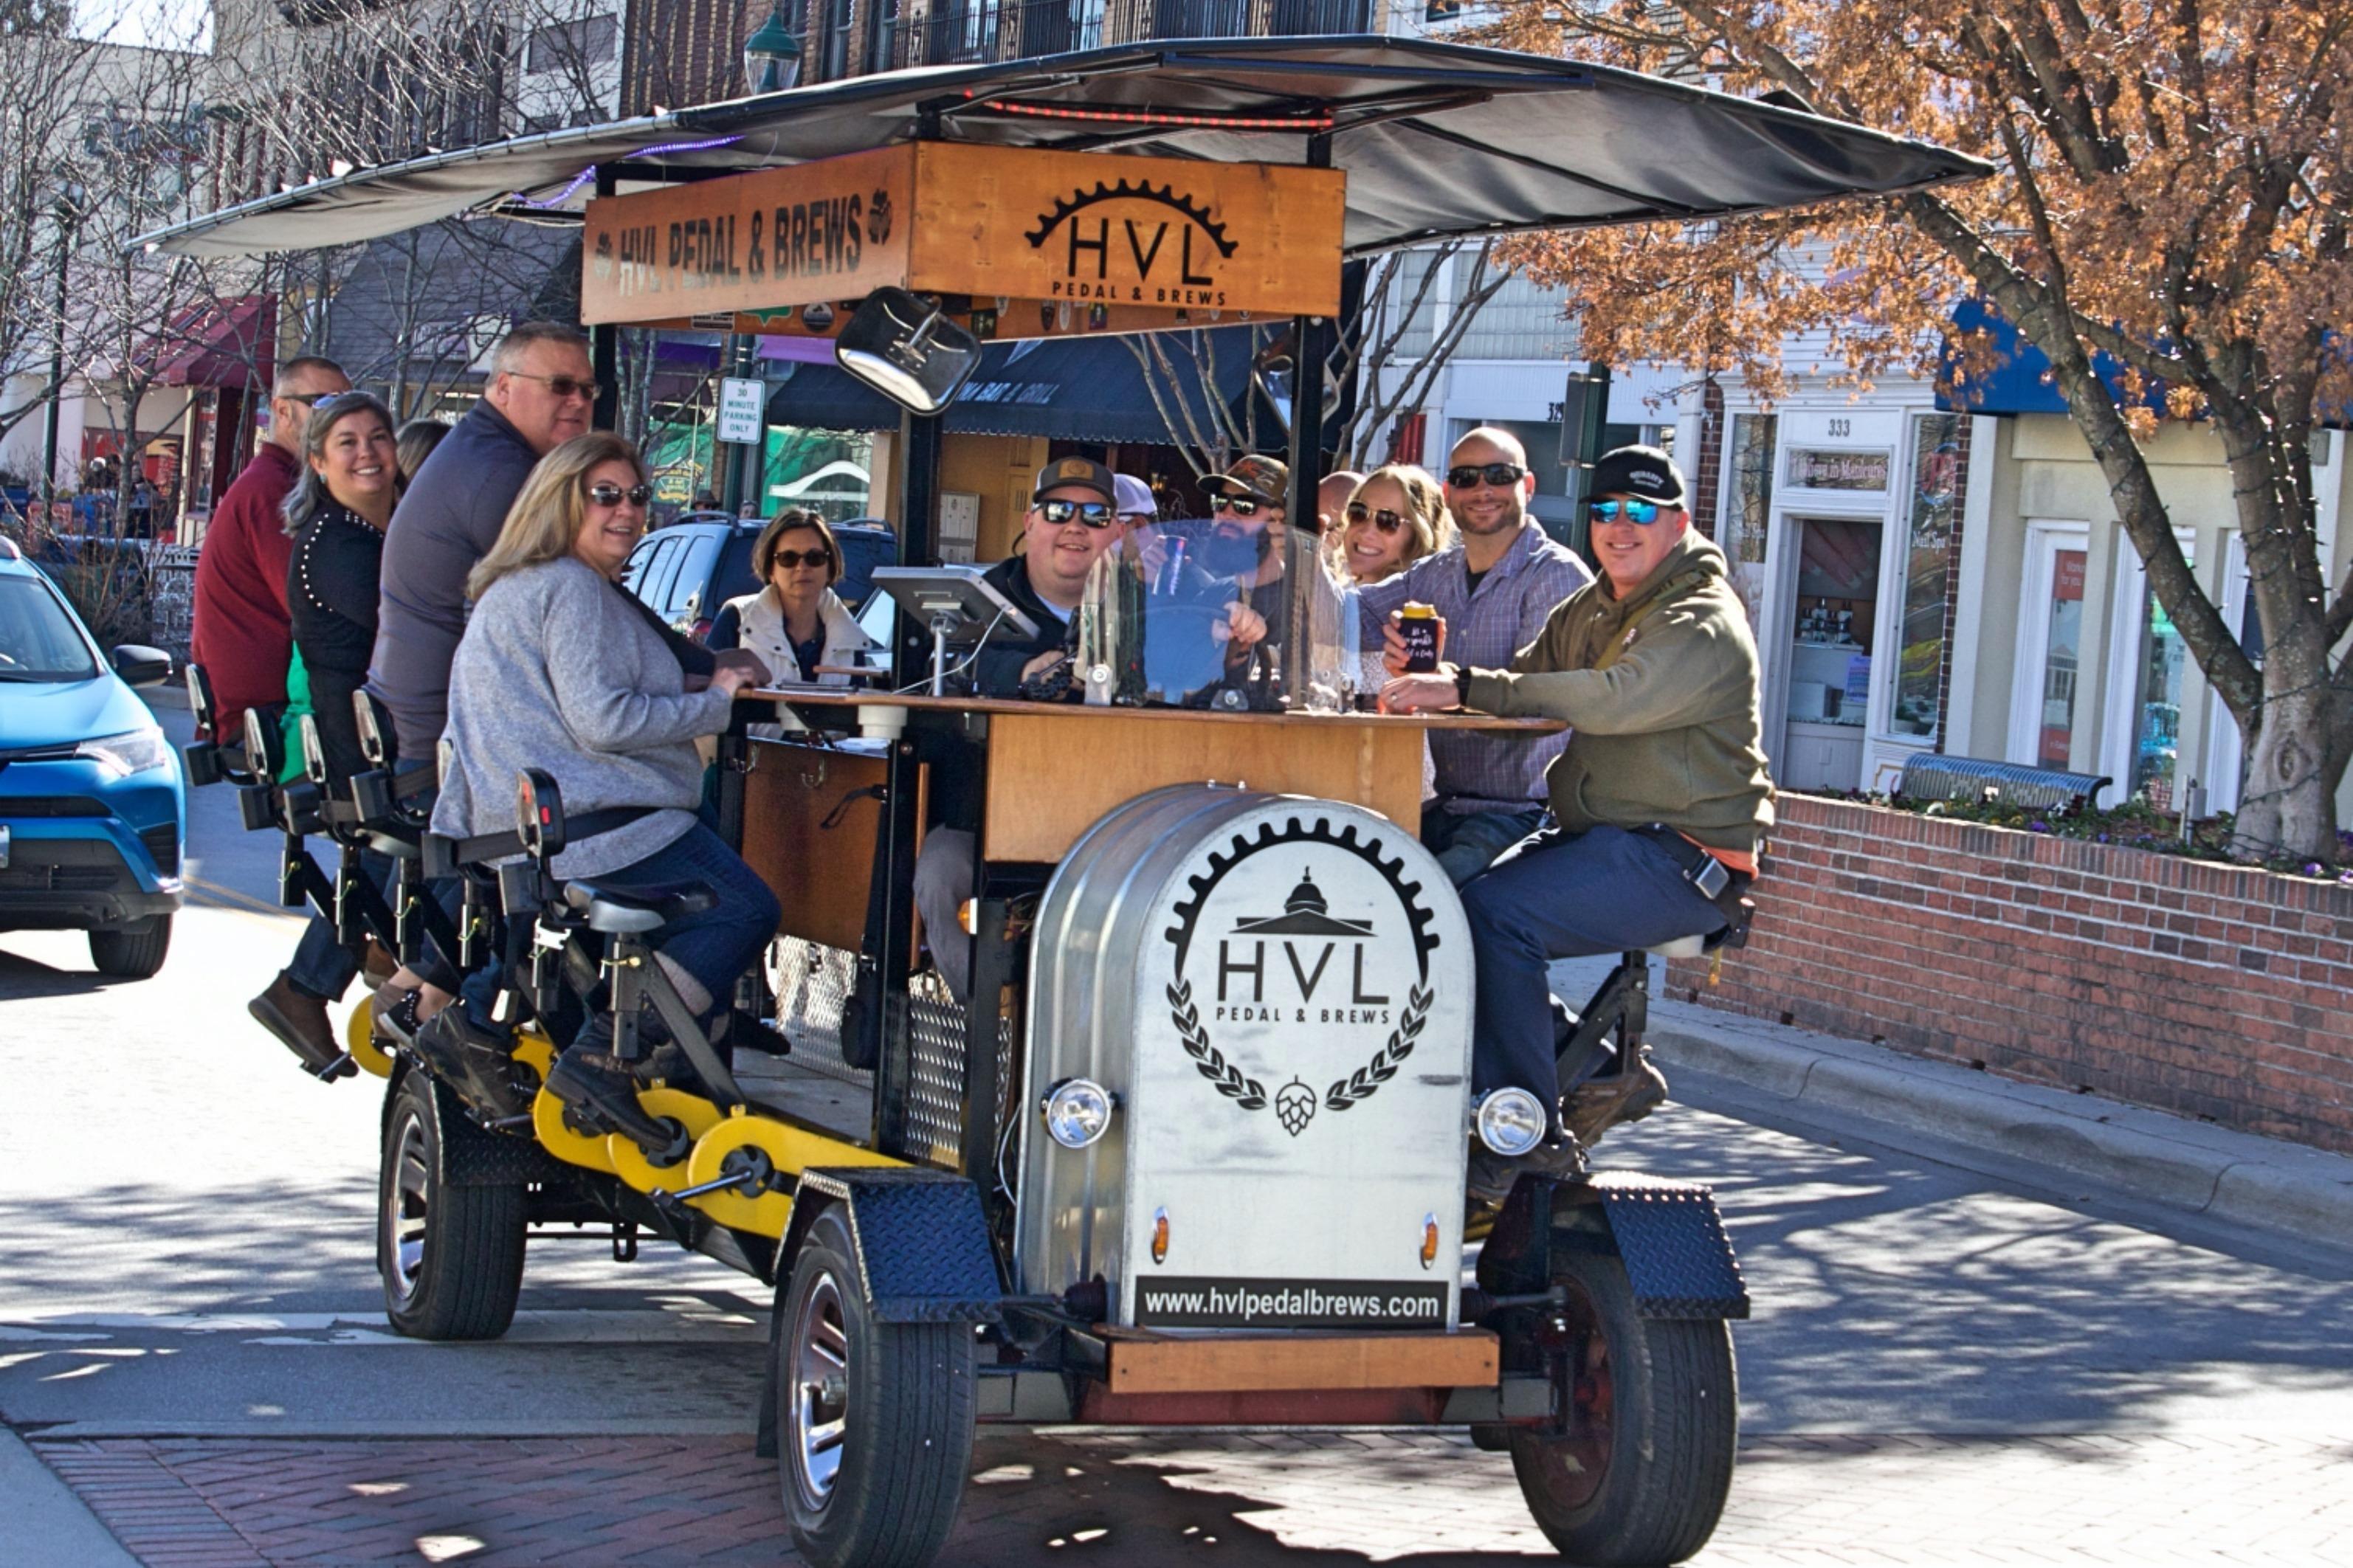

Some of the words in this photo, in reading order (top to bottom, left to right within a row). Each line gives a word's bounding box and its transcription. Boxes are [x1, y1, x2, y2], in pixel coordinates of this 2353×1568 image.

[620, 224, 662, 297] HVL
[668, 214, 740, 292] PEDAL
[748, 210, 765, 284] &
[773, 193, 863, 282] BREWS
[1068, 215, 1213, 286] HVL
[1052, 281, 1117, 300] PEDAL
[1131, 286, 1142, 301] &
[1157, 288, 1226, 306] BREWS
[723, 411, 758, 422] PARKING
[728, 401, 756, 410] MINUTE
[728, 424, 750, 433] ONLY
[1827, 418, 1850, 438] 333
[1217, 939, 1390, 1005] HVL
[1216, 1006, 1281, 1023] PEDAL
[1296, 1008, 1306, 1023] &
[1320, 1009, 1389, 1024] BREWS
[1145, 1286, 1440, 1322] www.hvlpedalbrews.com
